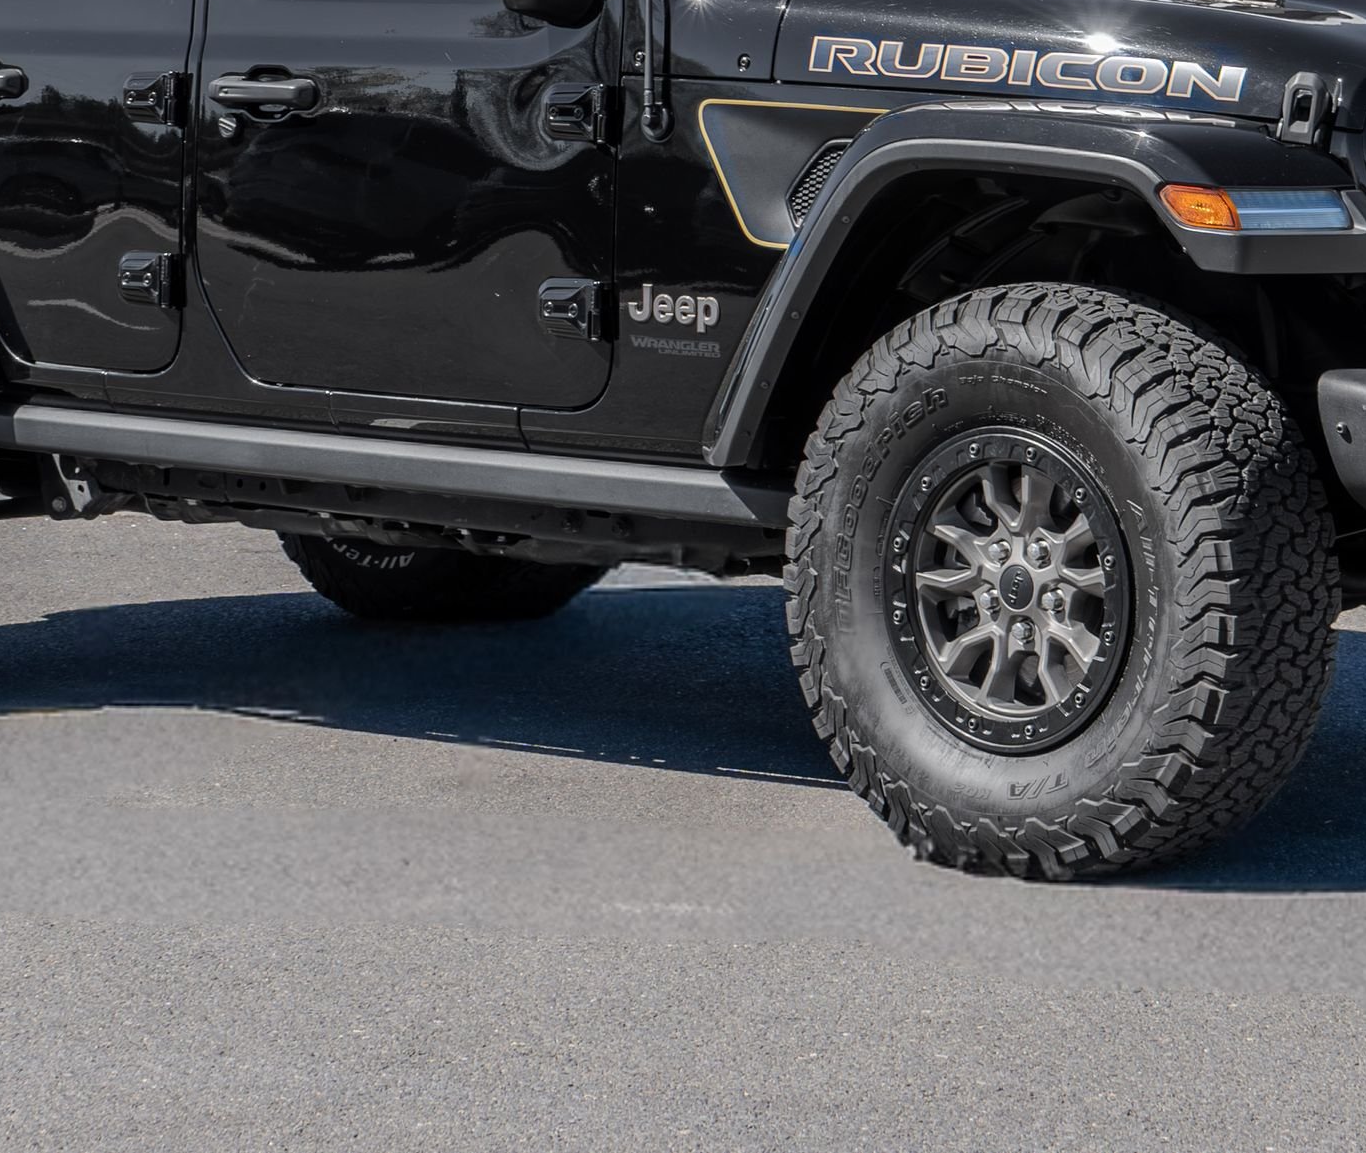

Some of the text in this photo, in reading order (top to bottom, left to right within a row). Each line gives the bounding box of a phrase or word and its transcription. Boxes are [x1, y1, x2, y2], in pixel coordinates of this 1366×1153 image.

[808, 35, 1247, 103] RUBICON
[627, 283, 720, 333] Jeep
[630, 335, 720, 352] WRANGLER
[658, 349, 721, 358] UNLIMITED
